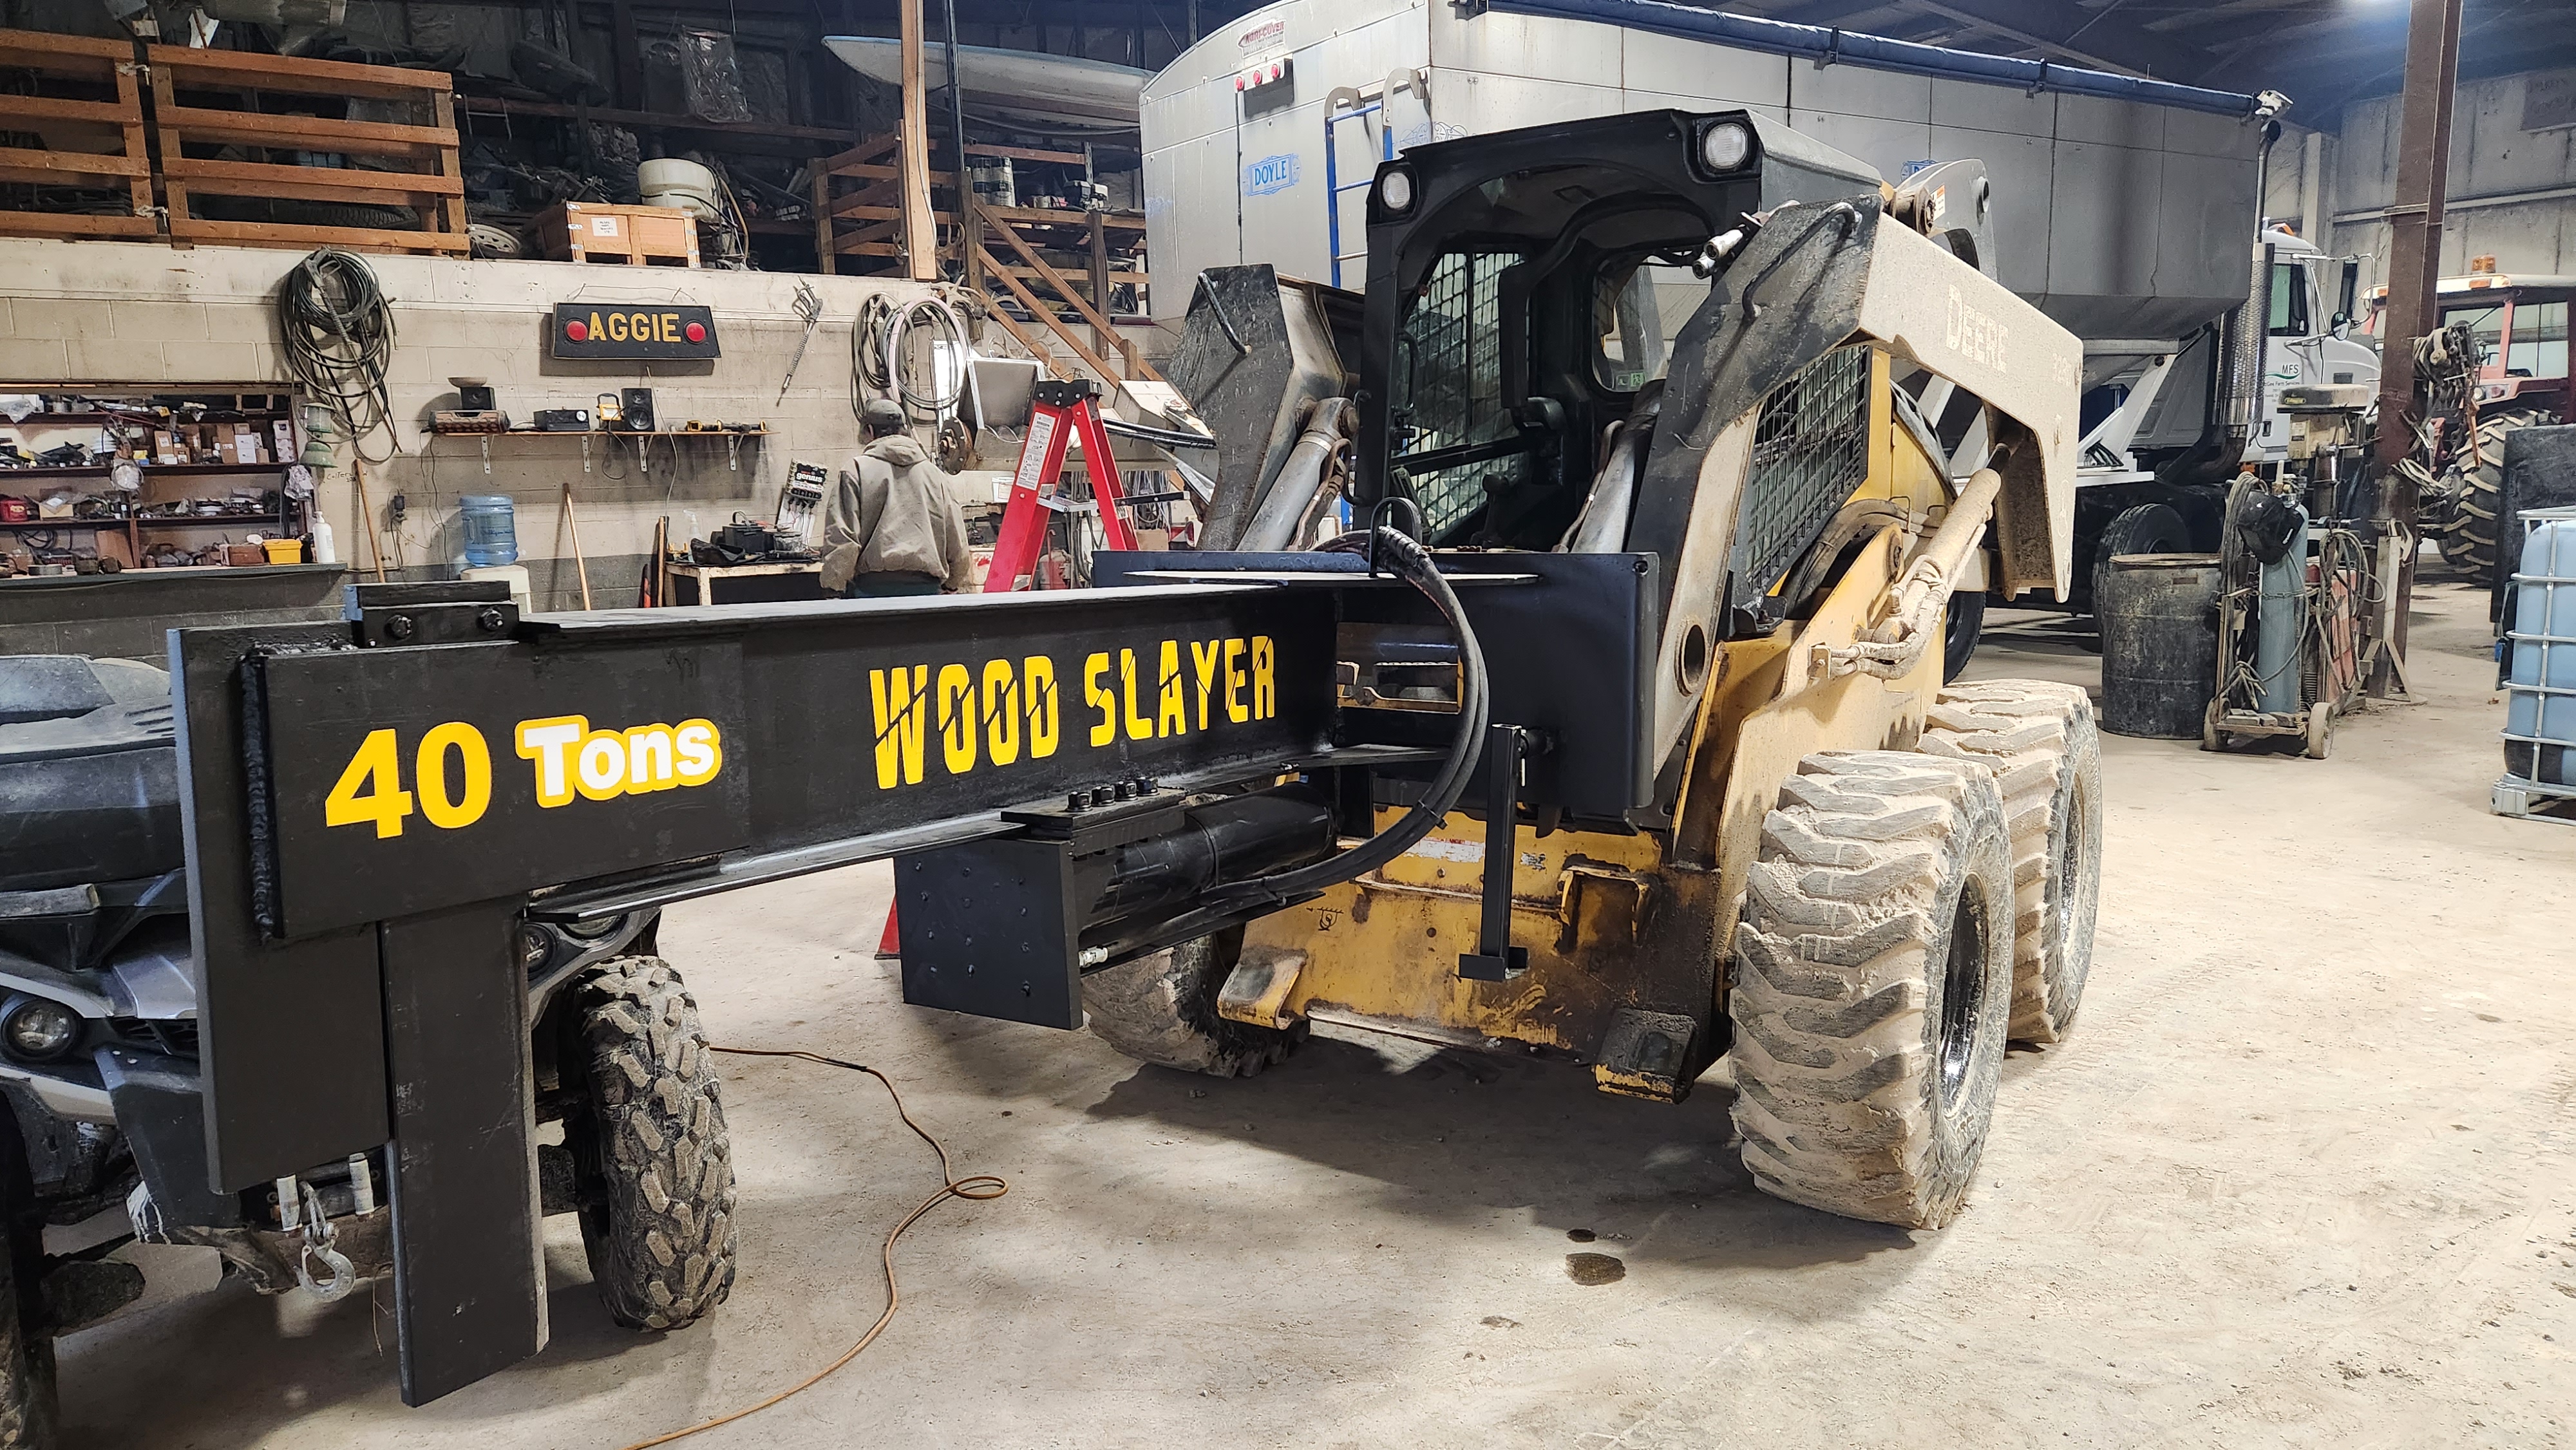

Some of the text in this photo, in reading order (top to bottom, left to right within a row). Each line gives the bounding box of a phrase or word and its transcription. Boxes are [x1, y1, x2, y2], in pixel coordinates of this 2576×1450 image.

[1255, 160, 1287, 185] DOYLE
[588, 312, 681, 343] AGGIE
[1946, 283, 2009, 375] DEERE
[2282, 364, 2299, 374] MFS
[796, 472, 823, 483] genius
[869, 636, 1275, 790] WOOD SLAYER
[325, 719, 719, 838] 40 Tons
